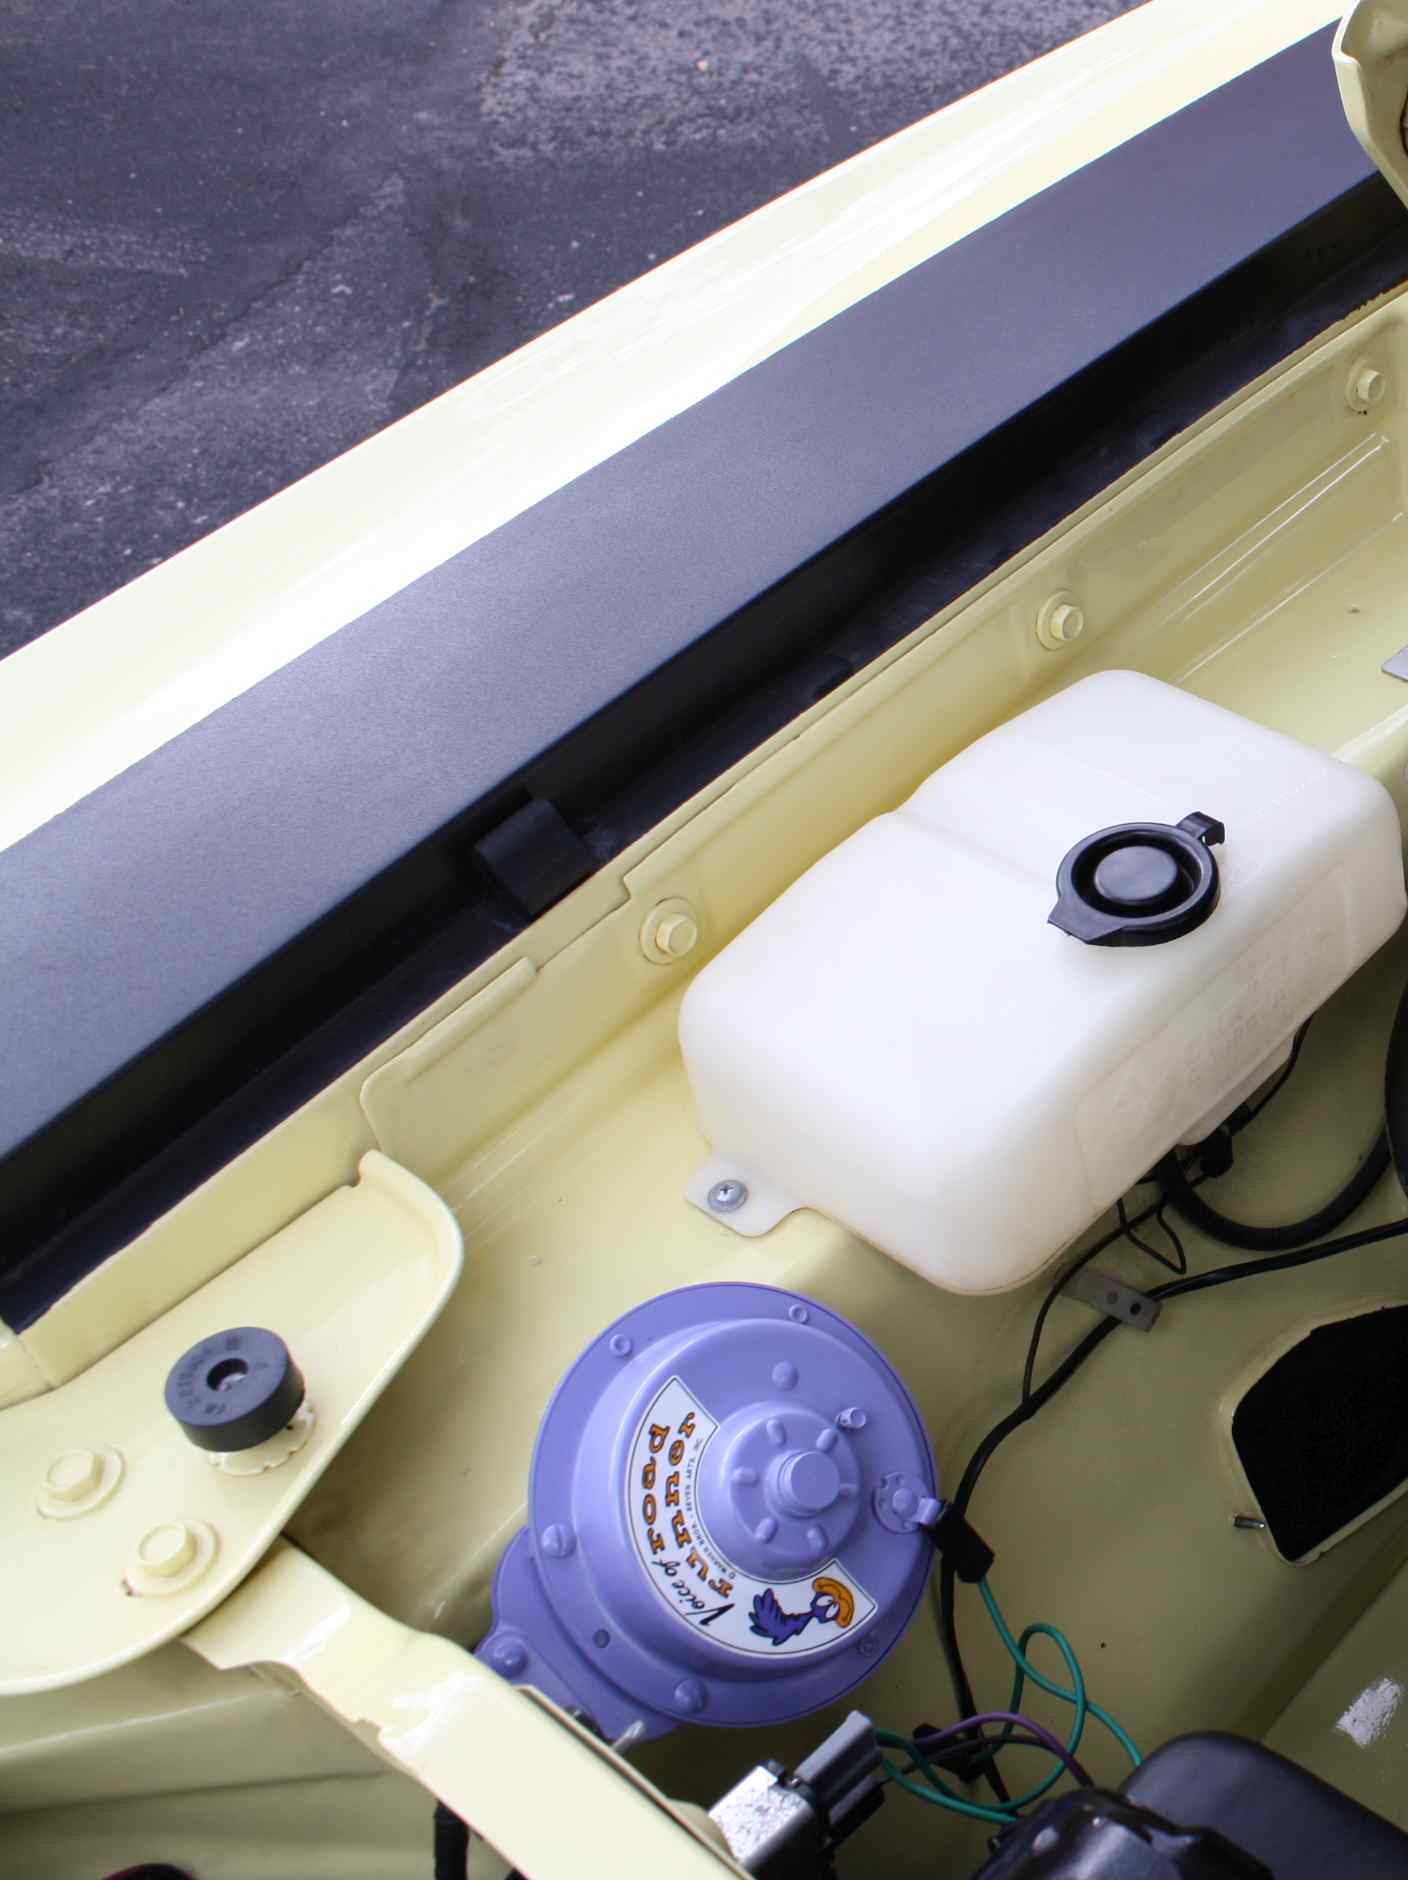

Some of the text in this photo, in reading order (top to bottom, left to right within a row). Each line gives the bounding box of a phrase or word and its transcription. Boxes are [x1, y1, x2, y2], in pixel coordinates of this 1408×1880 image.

[642, 1423, 735, 1626] Voice of road
